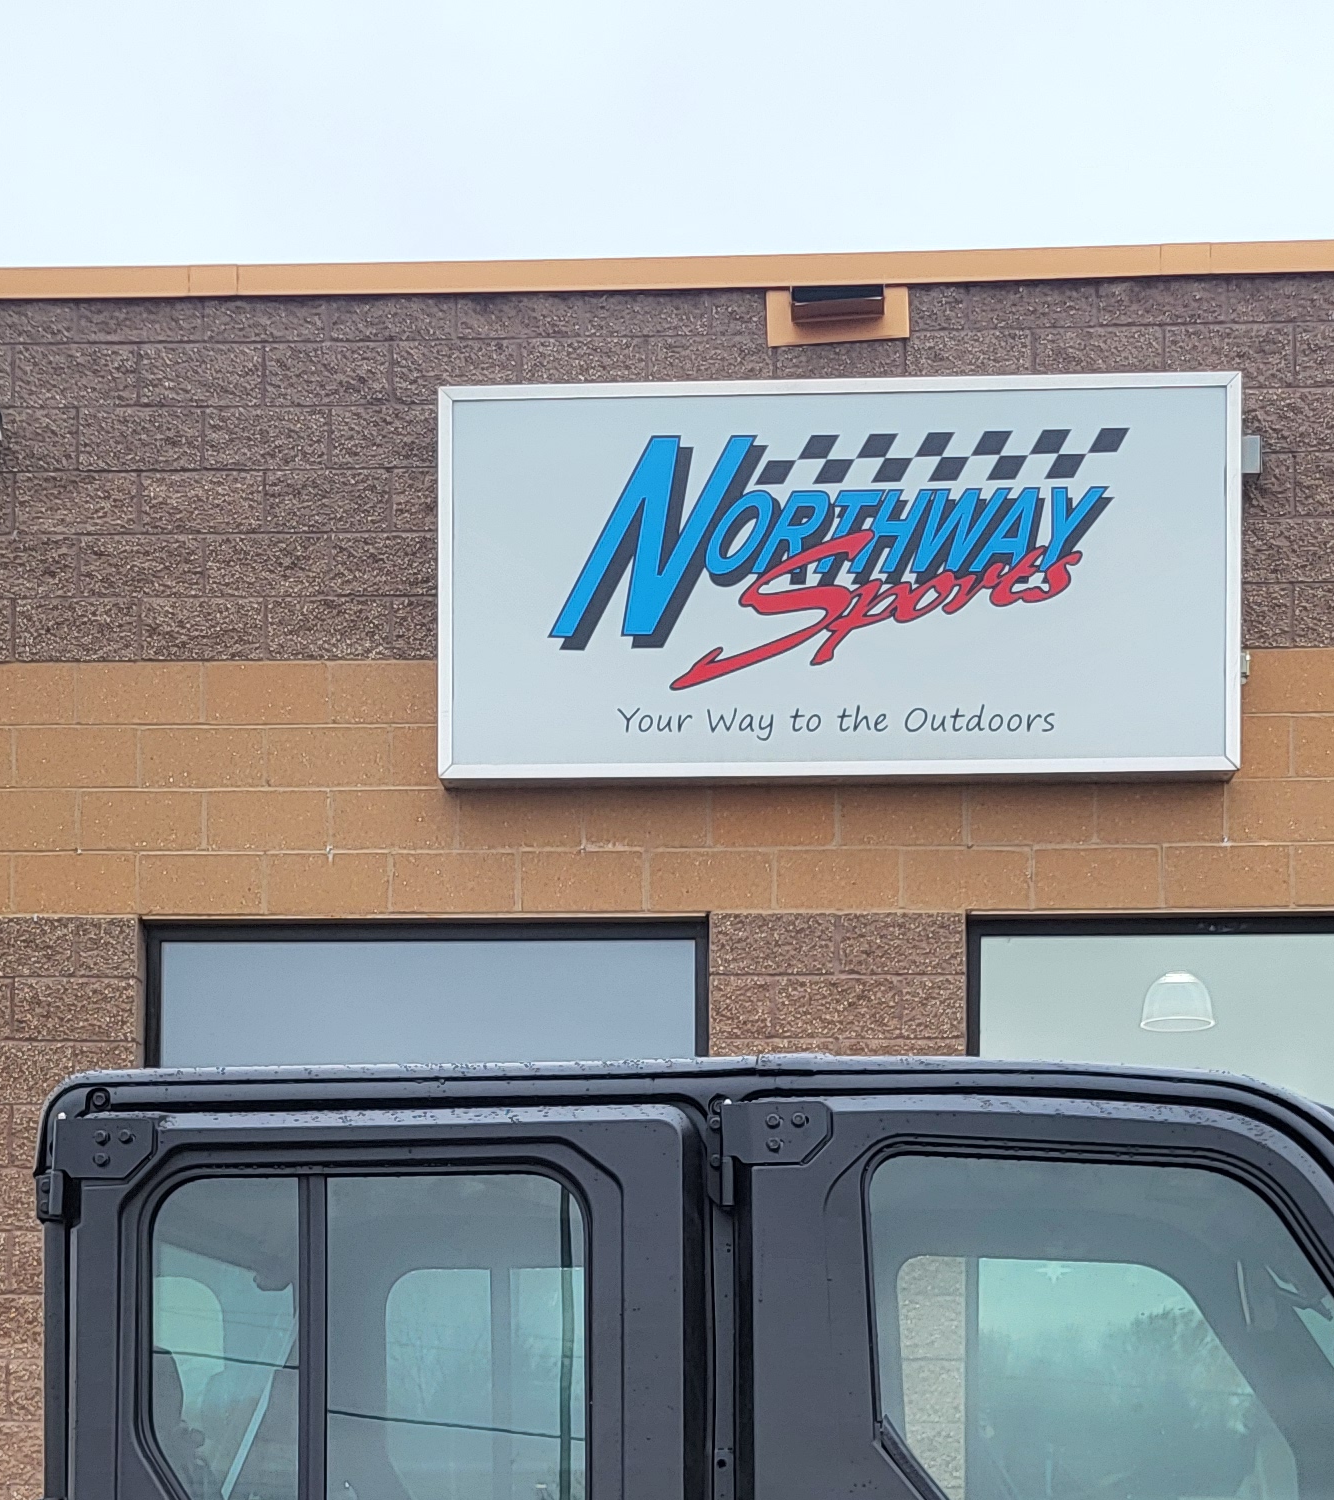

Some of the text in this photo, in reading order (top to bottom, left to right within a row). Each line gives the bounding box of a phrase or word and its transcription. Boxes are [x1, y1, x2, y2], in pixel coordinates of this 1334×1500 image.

[548, 434, 1113, 651] NORTHWAY
[669, 529, 1082, 691] Sports
[616, 703, 1057, 742] Your Way to the Outdoors
